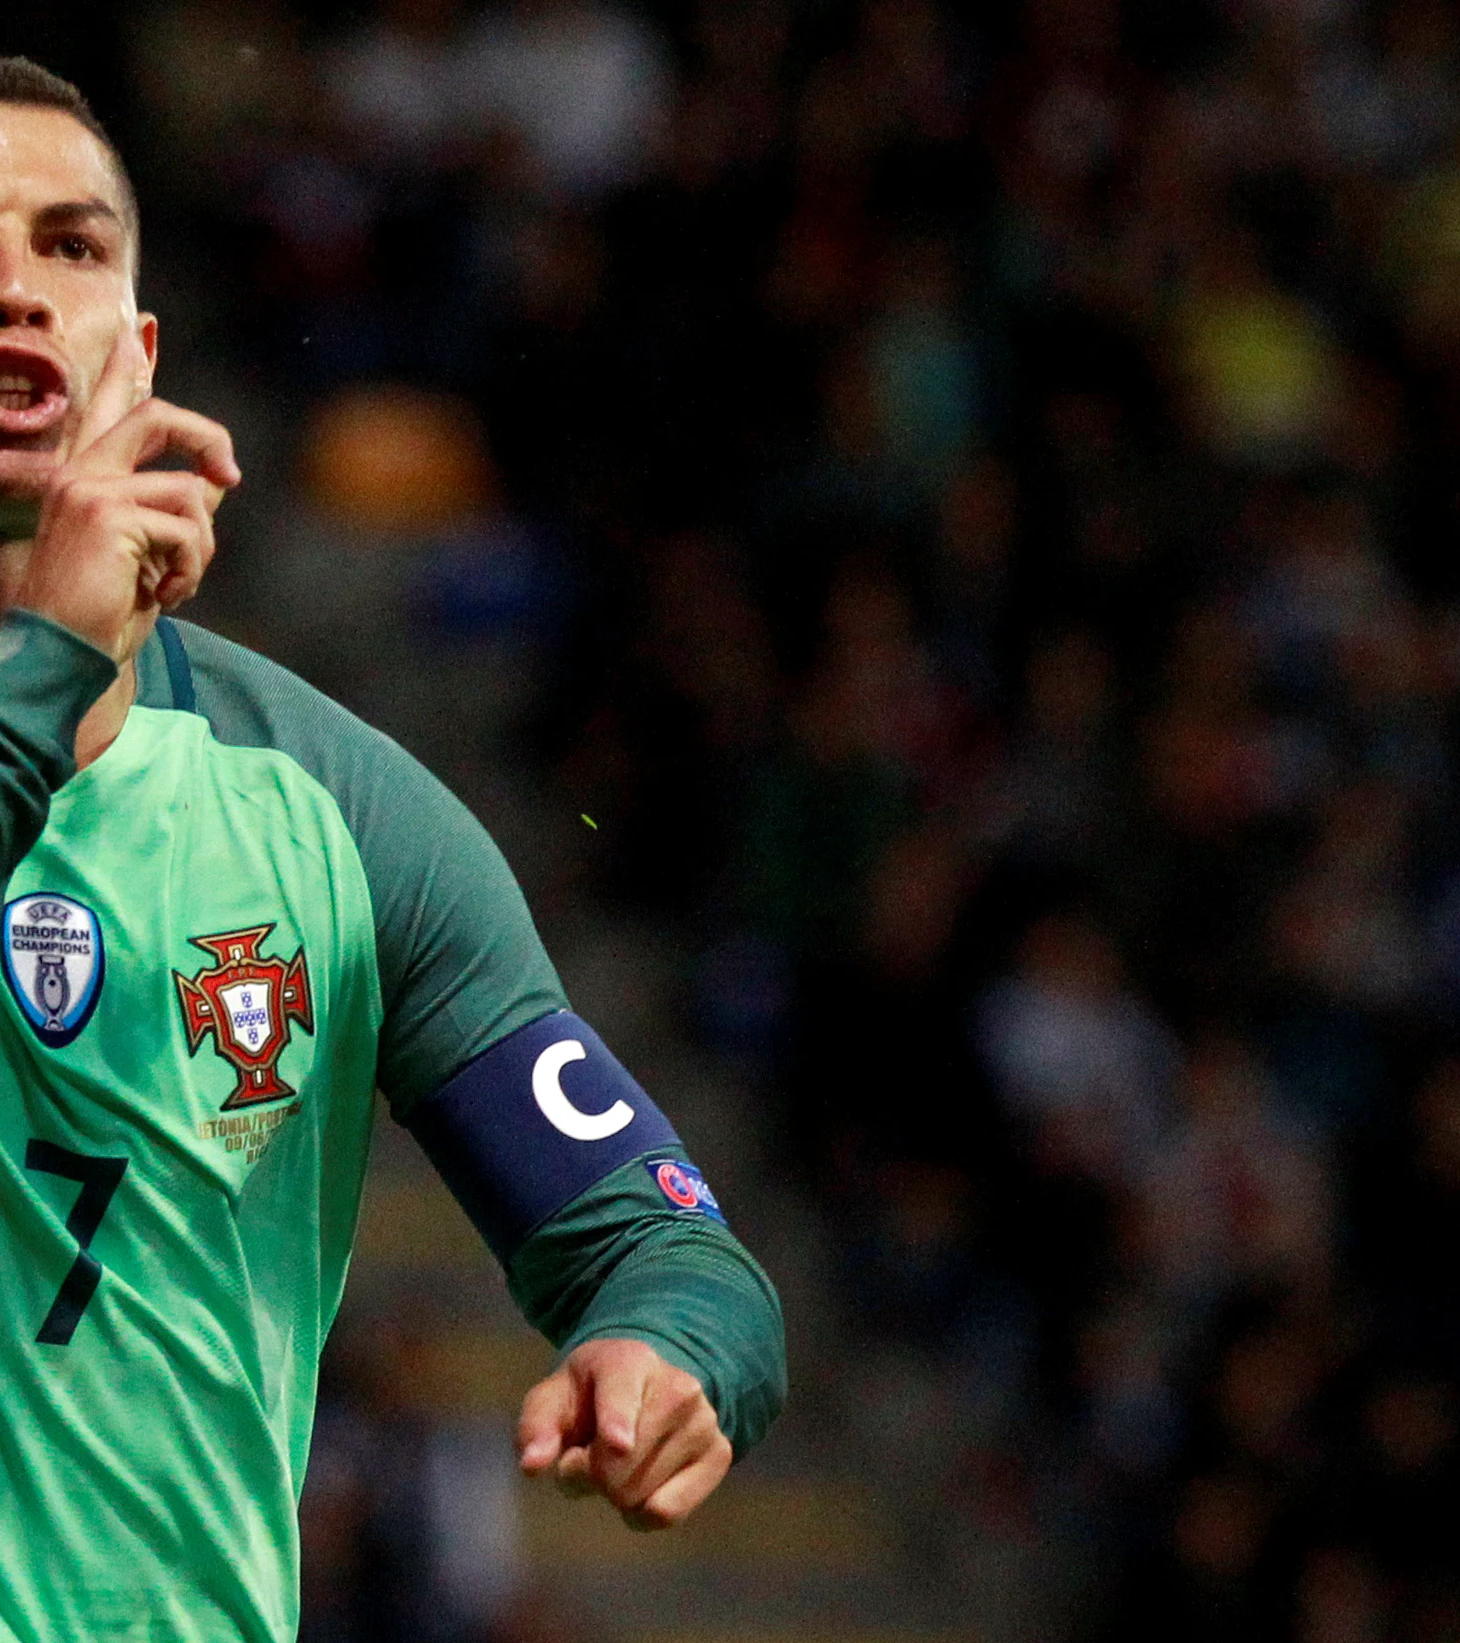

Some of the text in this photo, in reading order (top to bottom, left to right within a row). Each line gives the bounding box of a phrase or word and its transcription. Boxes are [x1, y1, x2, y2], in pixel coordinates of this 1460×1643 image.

[28, 903, 71, 921] UEFA
[12, 924, 90, 941] EUROPEAN
[12, 938, 91, 955] CHAMPIONS
[532, 1039, 635, 1141] C
[25, 1138, 129, 1346] 7
